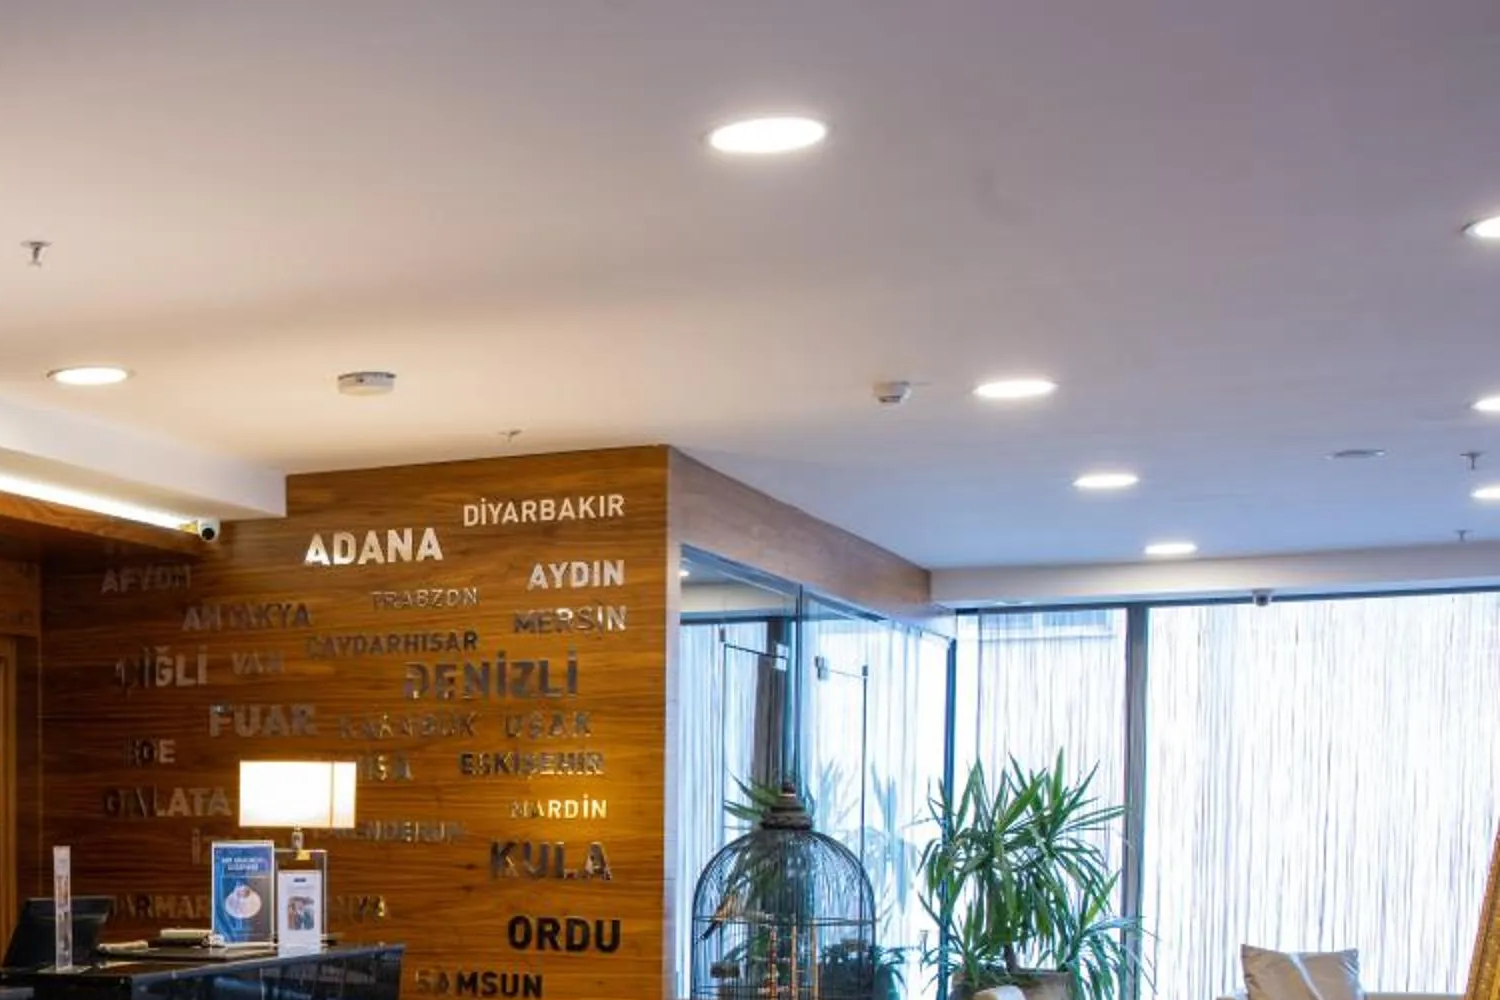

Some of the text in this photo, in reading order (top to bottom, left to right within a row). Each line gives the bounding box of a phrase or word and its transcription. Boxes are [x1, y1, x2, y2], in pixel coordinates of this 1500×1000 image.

[463, 494, 625, 528] DİYARBAKIR
[304, 527, 443, 567] ADANA
[527, 560, 625, 590] AYDIN
[370, 586, 477, 611] TRABZON
[404, 648, 578, 700] DENİZLİ
[209, 702, 316, 738] FUAR
[510, 794, 608, 820] MARDİN
[489, 841, 613, 881] KULA
[507, 915, 621, 953] ORDU
[415, 970, 543, 998] SAMSUN
